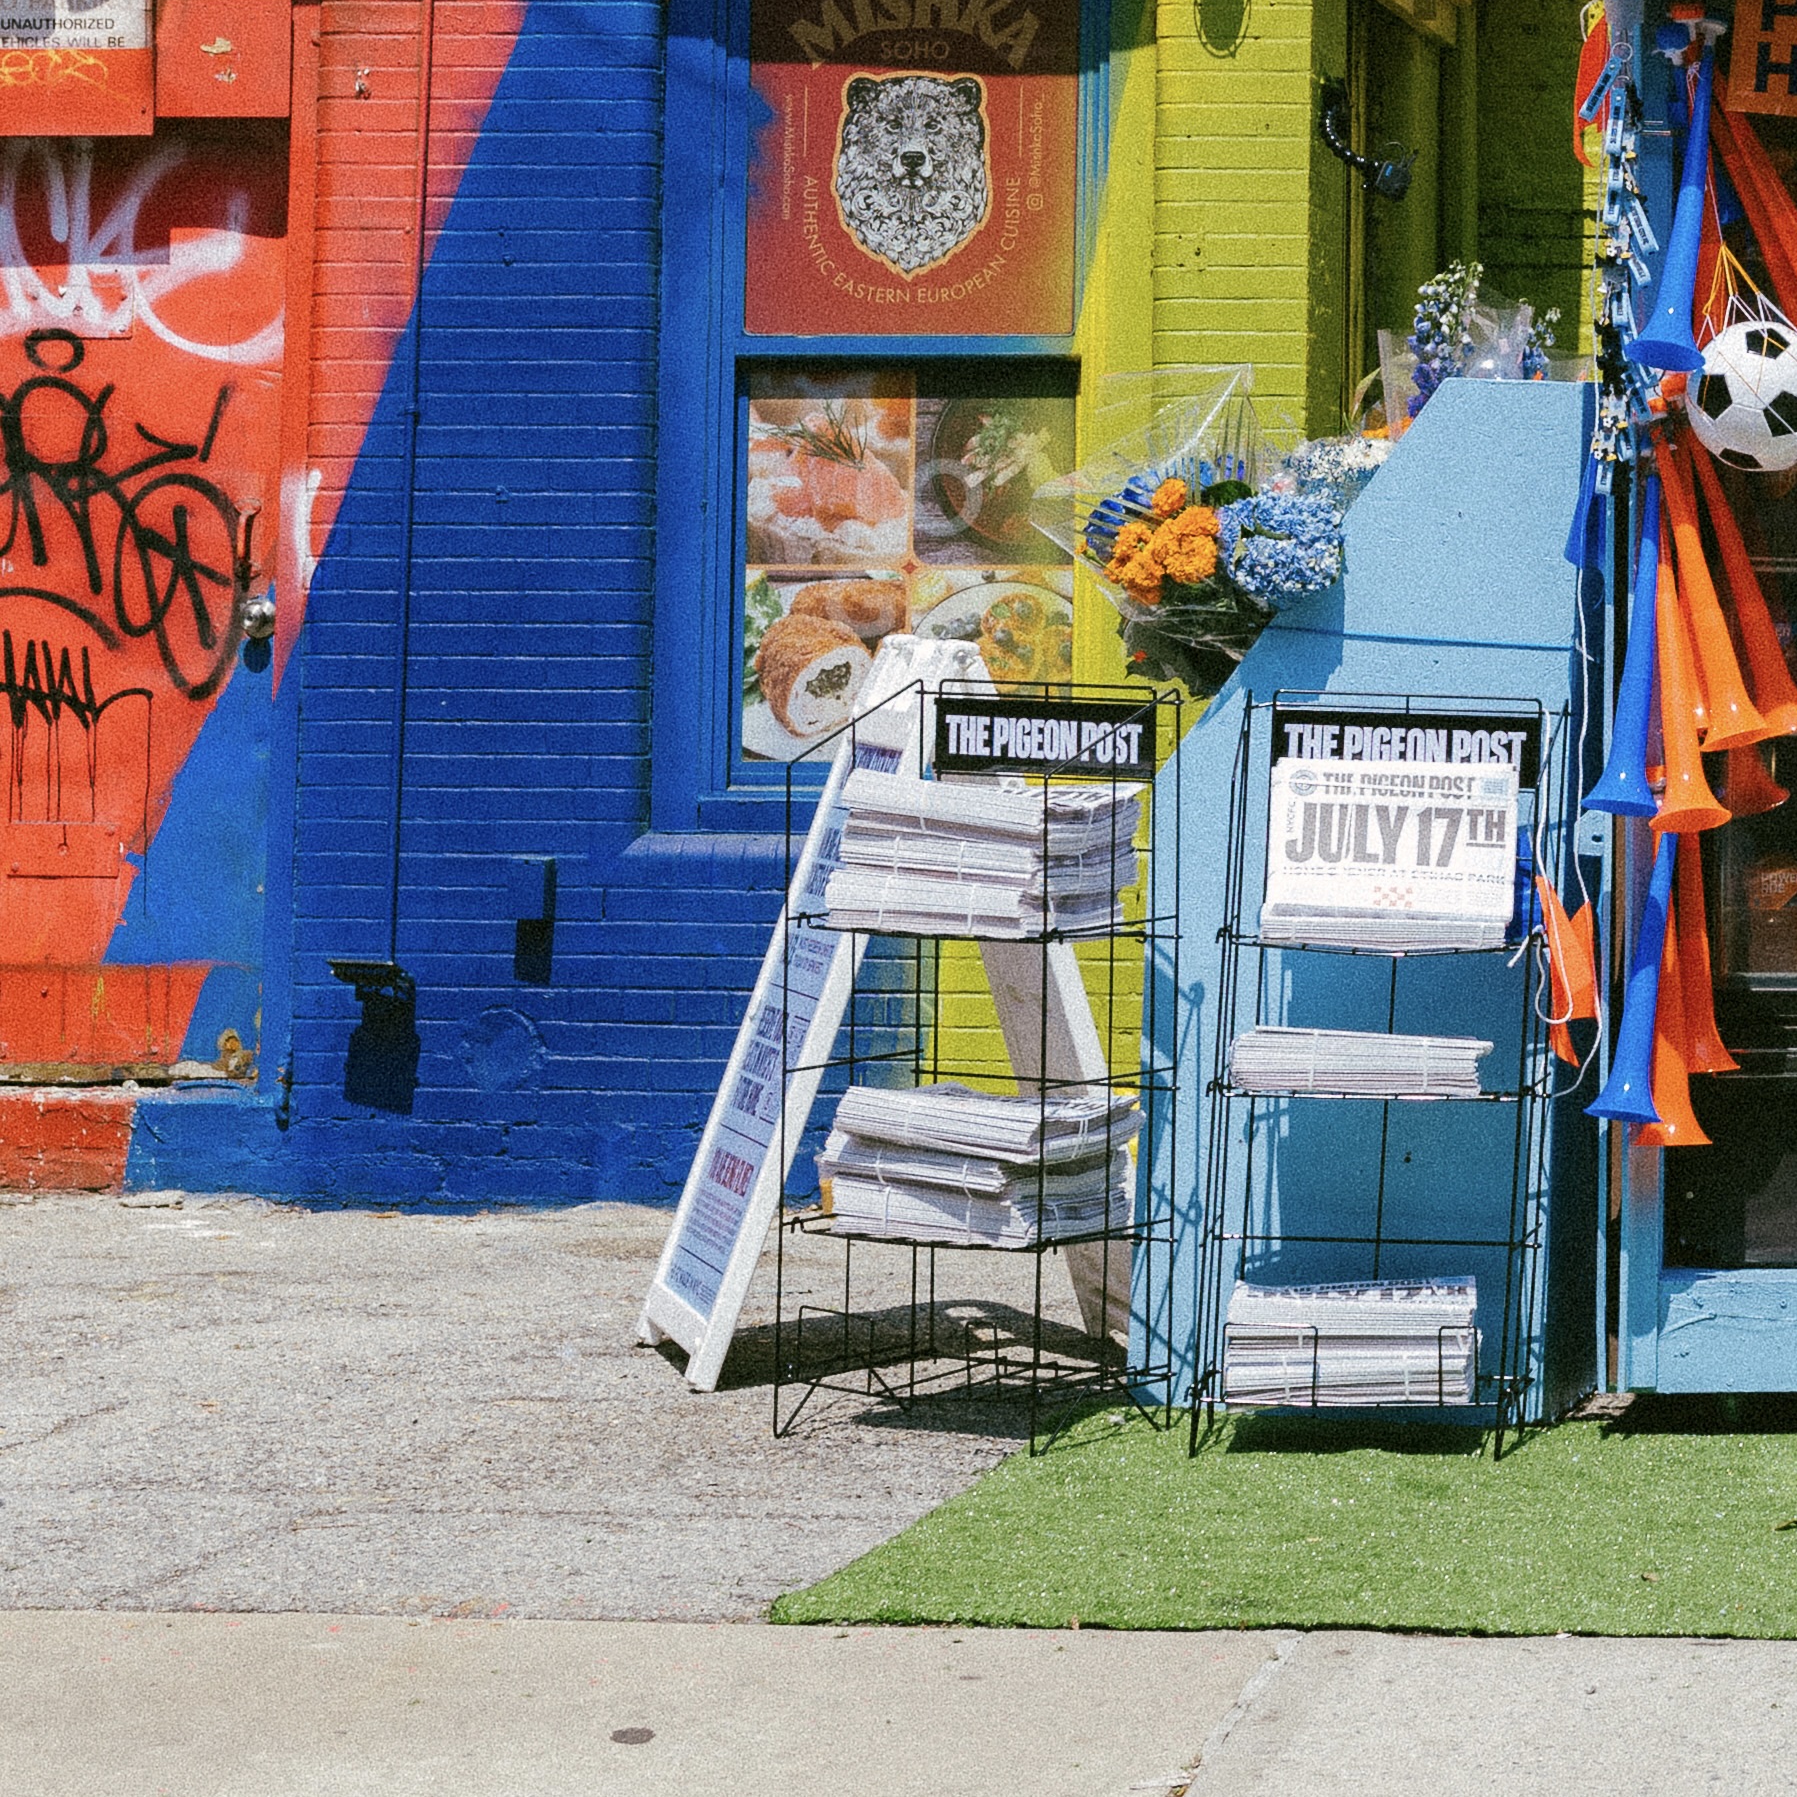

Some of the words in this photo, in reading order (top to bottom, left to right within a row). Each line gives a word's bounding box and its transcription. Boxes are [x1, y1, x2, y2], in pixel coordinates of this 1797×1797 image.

[1, 18, 115, 30] UNAUTHORIZED
[1, 37, 60, 48] EHICLES
[68, 37, 100, 48] WILL
[108, 37, 125, 48] BE
[881, 40, 949, 61] SOHO
[802, 175, 835, 276] AUTHENTIC
[832, 272, 911, 303] EASTERN
[918, 254, 1008, 303] EUROPEAN
[1001, 176, 1021, 251] CUISINE
[945, 714, 991, 754] THE
[993, 717, 1077, 761] PIGEON
[1081, 722, 1143, 765] POST
[1284, 723, 1340, 760] THE
[1344, 726, 1448, 763] PIGEON
[1452, 729, 1527, 772] POST
[1285, 802, 1410, 865] JULY
[1417, 806, 1507, 868] 17TH
